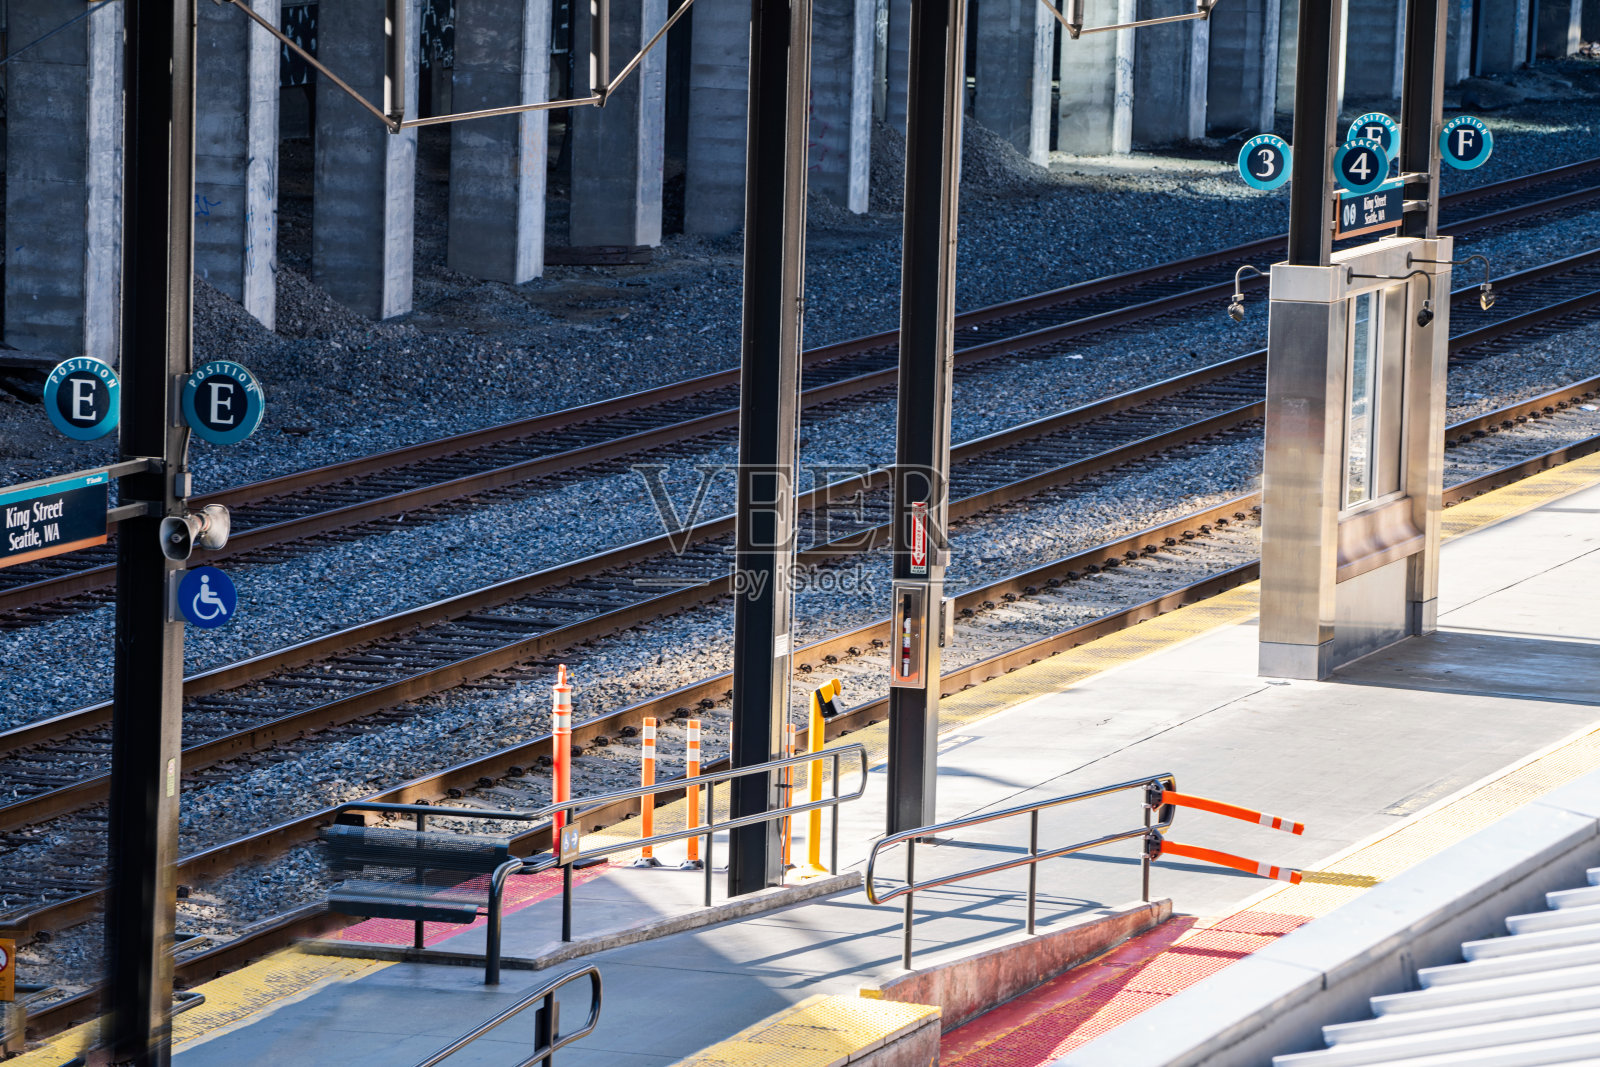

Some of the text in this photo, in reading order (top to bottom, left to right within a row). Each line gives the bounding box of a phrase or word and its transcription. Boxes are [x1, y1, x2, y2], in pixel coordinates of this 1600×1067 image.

[1352, 114, 1397, 132] POSITION
[1443, 116, 1489, 135] POSITION
[1249, 135, 1284, 149] TRACK
[1344, 139, 1379, 151] TRACK
[1456, 129, 1475, 156] F
[1255, 149, 1275, 177] 3
[1349, 152, 1371, 180] 4
[1363, 197, 1374, 212] King
[51, 360, 117, 388] POSITION
[188, 364, 255, 392] POSITION
[69, 378, 97, 421] E
[207, 382, 235, 424] E
[6, 499, 64, 530] King Street
[8, 523, 60, 551] Seattle, WA
